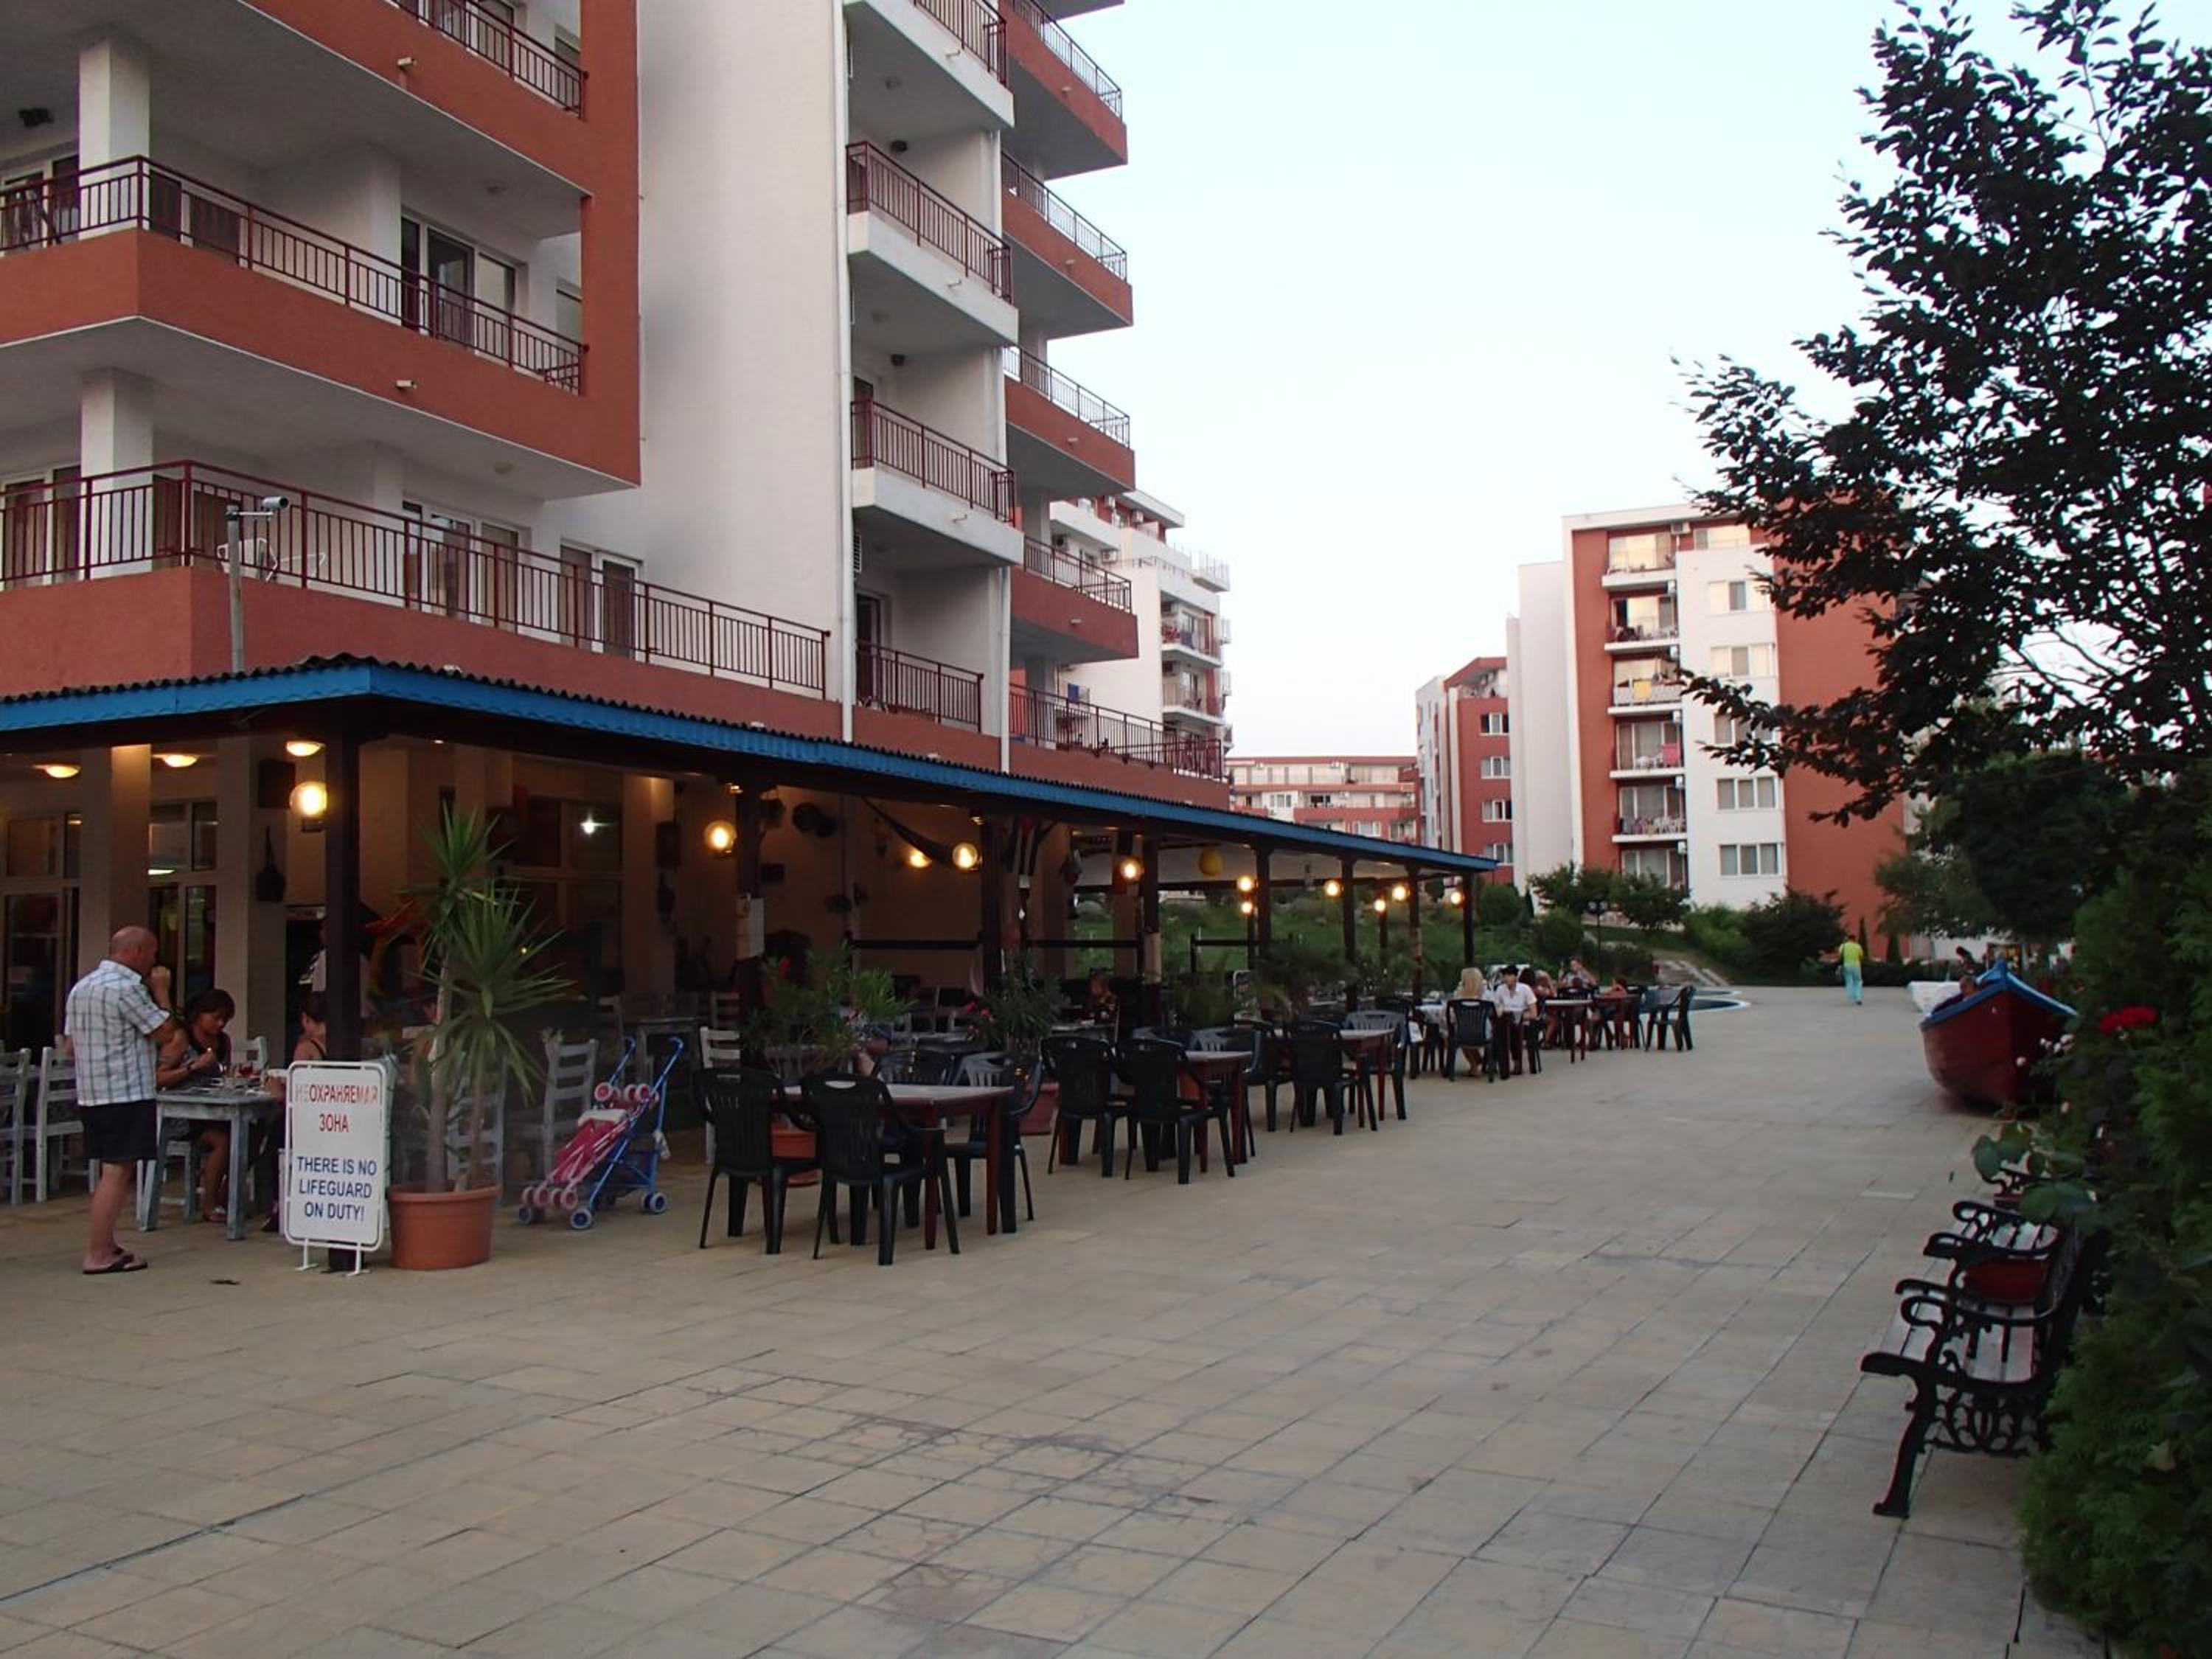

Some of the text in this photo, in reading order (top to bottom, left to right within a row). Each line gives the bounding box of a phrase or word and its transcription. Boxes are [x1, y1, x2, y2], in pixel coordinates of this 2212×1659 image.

[319, 1113, 349, 1133] ЗОНА
[297, 1155, 377, 1176] THERE IS NO
[299, 1178, 372, 1198] LIFEGUARD
[305, 1201, 364, 1222] ON DUTY!
